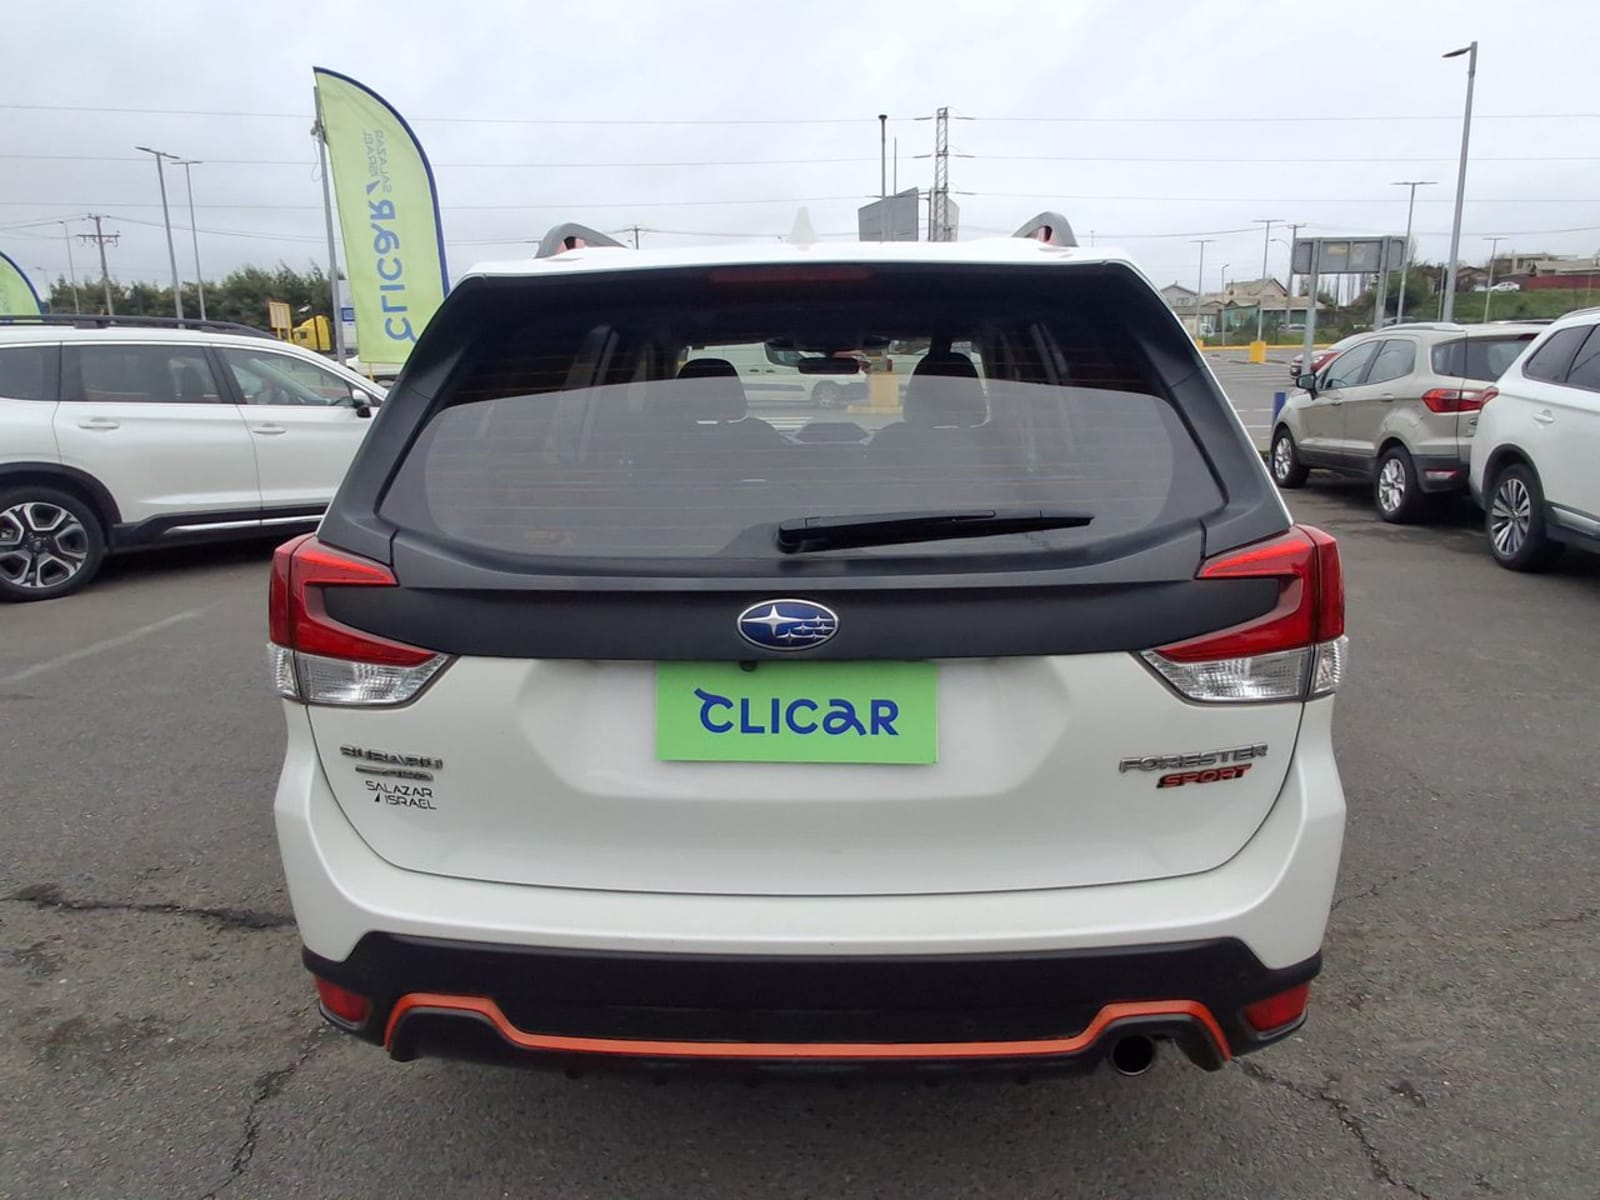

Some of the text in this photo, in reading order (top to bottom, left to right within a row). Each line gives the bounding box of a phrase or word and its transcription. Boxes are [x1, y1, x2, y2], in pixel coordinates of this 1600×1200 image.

[340, 745, 443, 770] SUBARU
[1119, 743, 1268, 773] FORESTER
[1156, 763, 1252, 788] SPORT
[365, 780, 433, 798] SALAZAR
[385, 795, 437, 810] ISRAEL
